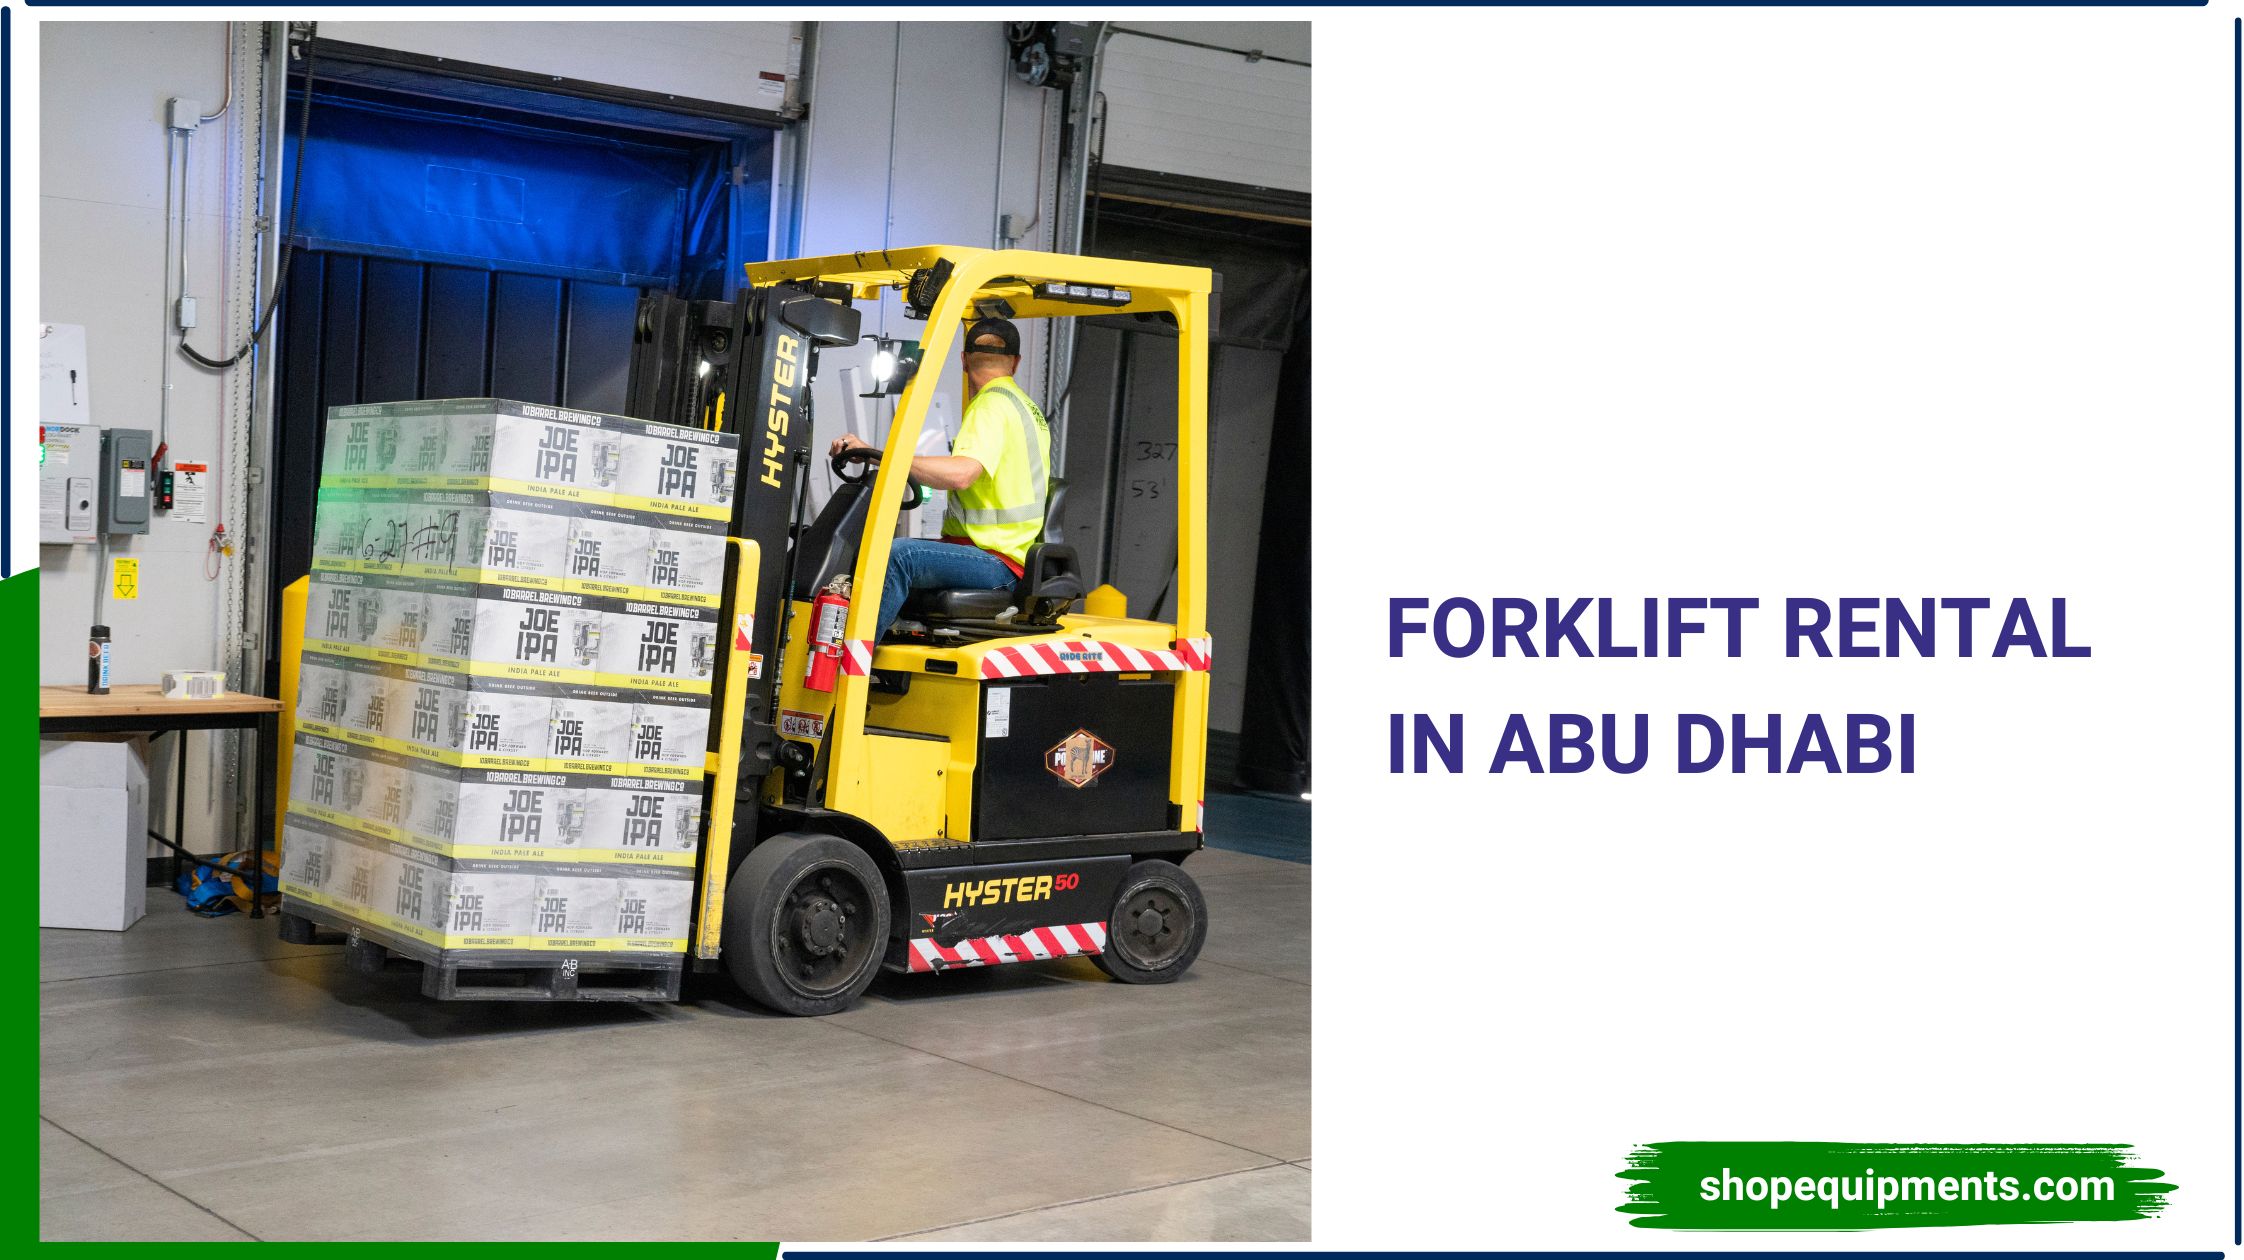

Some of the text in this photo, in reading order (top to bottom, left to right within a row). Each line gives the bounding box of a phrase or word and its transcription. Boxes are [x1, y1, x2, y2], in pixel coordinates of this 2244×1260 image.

[761, 334, 798, 488] HYSTER
[347, 422, 370, 443] JOE
[539, 426, 580, 452] JOE
[344, 444, 368, 471] IPA
[661, 444, 699, 470] JOE
[1137, 442, 1178, 460] 327
[536, 450, 577, 482] IPA
[528, 485, 579, 497] INDIA PALE ALE
[658, 468, 697, 498] IPA
[650, 501, 668, 509] INDIA
[671, 503, 686, 511] PALE
[490, 530, 518, 547] JOE
[575, 539, 601, 557] JOE
[488, 547, 516, 568] IPA
[573, 555, 600, 577] IPA
[654, 550, 679, 566] JOE
[652, 565, 678, 587] IPA
[329, 589, 351, 610] JOE
[325, 611, 349, 638] IPA
[452, 618, 471, 635] JOE
[520, 608, 560, 632] JOE
[641, 621, 679, 644] JOE
[450, 634, 470, 656] IPA
[516, 631, 559, 662] IPA
[638, 644, 677, 673] IPA
[415, 688, 440, 712] JOE
[412, 711, 438, 742] IPA
[472, 714, 500, 731] JOE
[557, 720, 583, 736] JOE
[637, 725, 663, 741] JOE
[470, 730, 498, 751] IPA
[555, 736, 581, 756] IPA
[635, 741, 661, 760] IPA
[314, 753, 335, 777] JOE
[311, 775, 333, 805] IPA
[503, 790, 544, 813] JOE
[626, 795, 664, 818] JOE
[500, 814, 541, 843] IPA
[623, 818, 661, 846] IPA
[398, 863, 424, 891] JOE
[943, 873, 1079, 909] HYSTER 50
[396, 886, 422, 920] IPA
[456, 895, 484, 910] JOE
[541, 898, 567, 913] JOE
[621, 899, 646, 914] JOE
[454, 911, 482, 931] IPA
[539, 914, 566, 933] IPA
[618, 915, 644, 934] IPA
